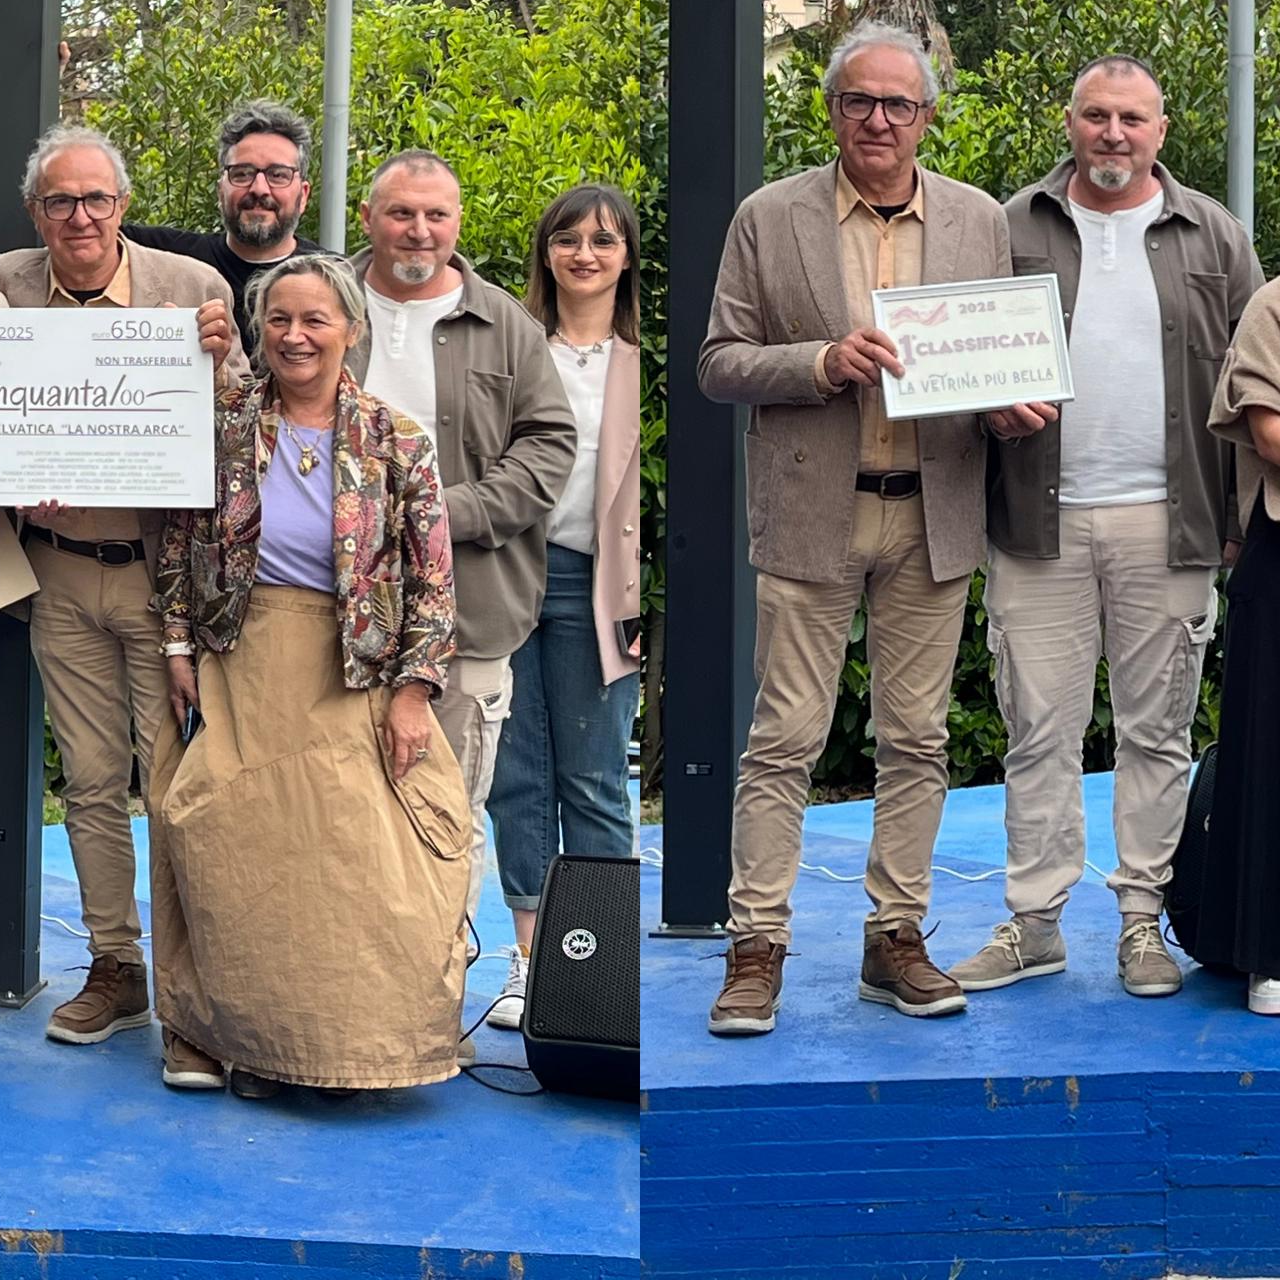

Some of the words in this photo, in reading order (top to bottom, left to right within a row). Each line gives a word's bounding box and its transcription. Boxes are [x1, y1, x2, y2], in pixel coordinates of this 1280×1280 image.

[958, 301, 996, 314] 2025
[916, 331, 1050, 356] CLASSIFICATA
[95, 357, 120, 366] NON
[123, 357, 192, 366] TRASFERIBILE
[921, 371, 980, 393] VETRINA
[985, 370, 1007, 386] PIÙ
[1013, 368, 1054, 384] BELLA
[87, 425, 141, 435] NOSTRA
